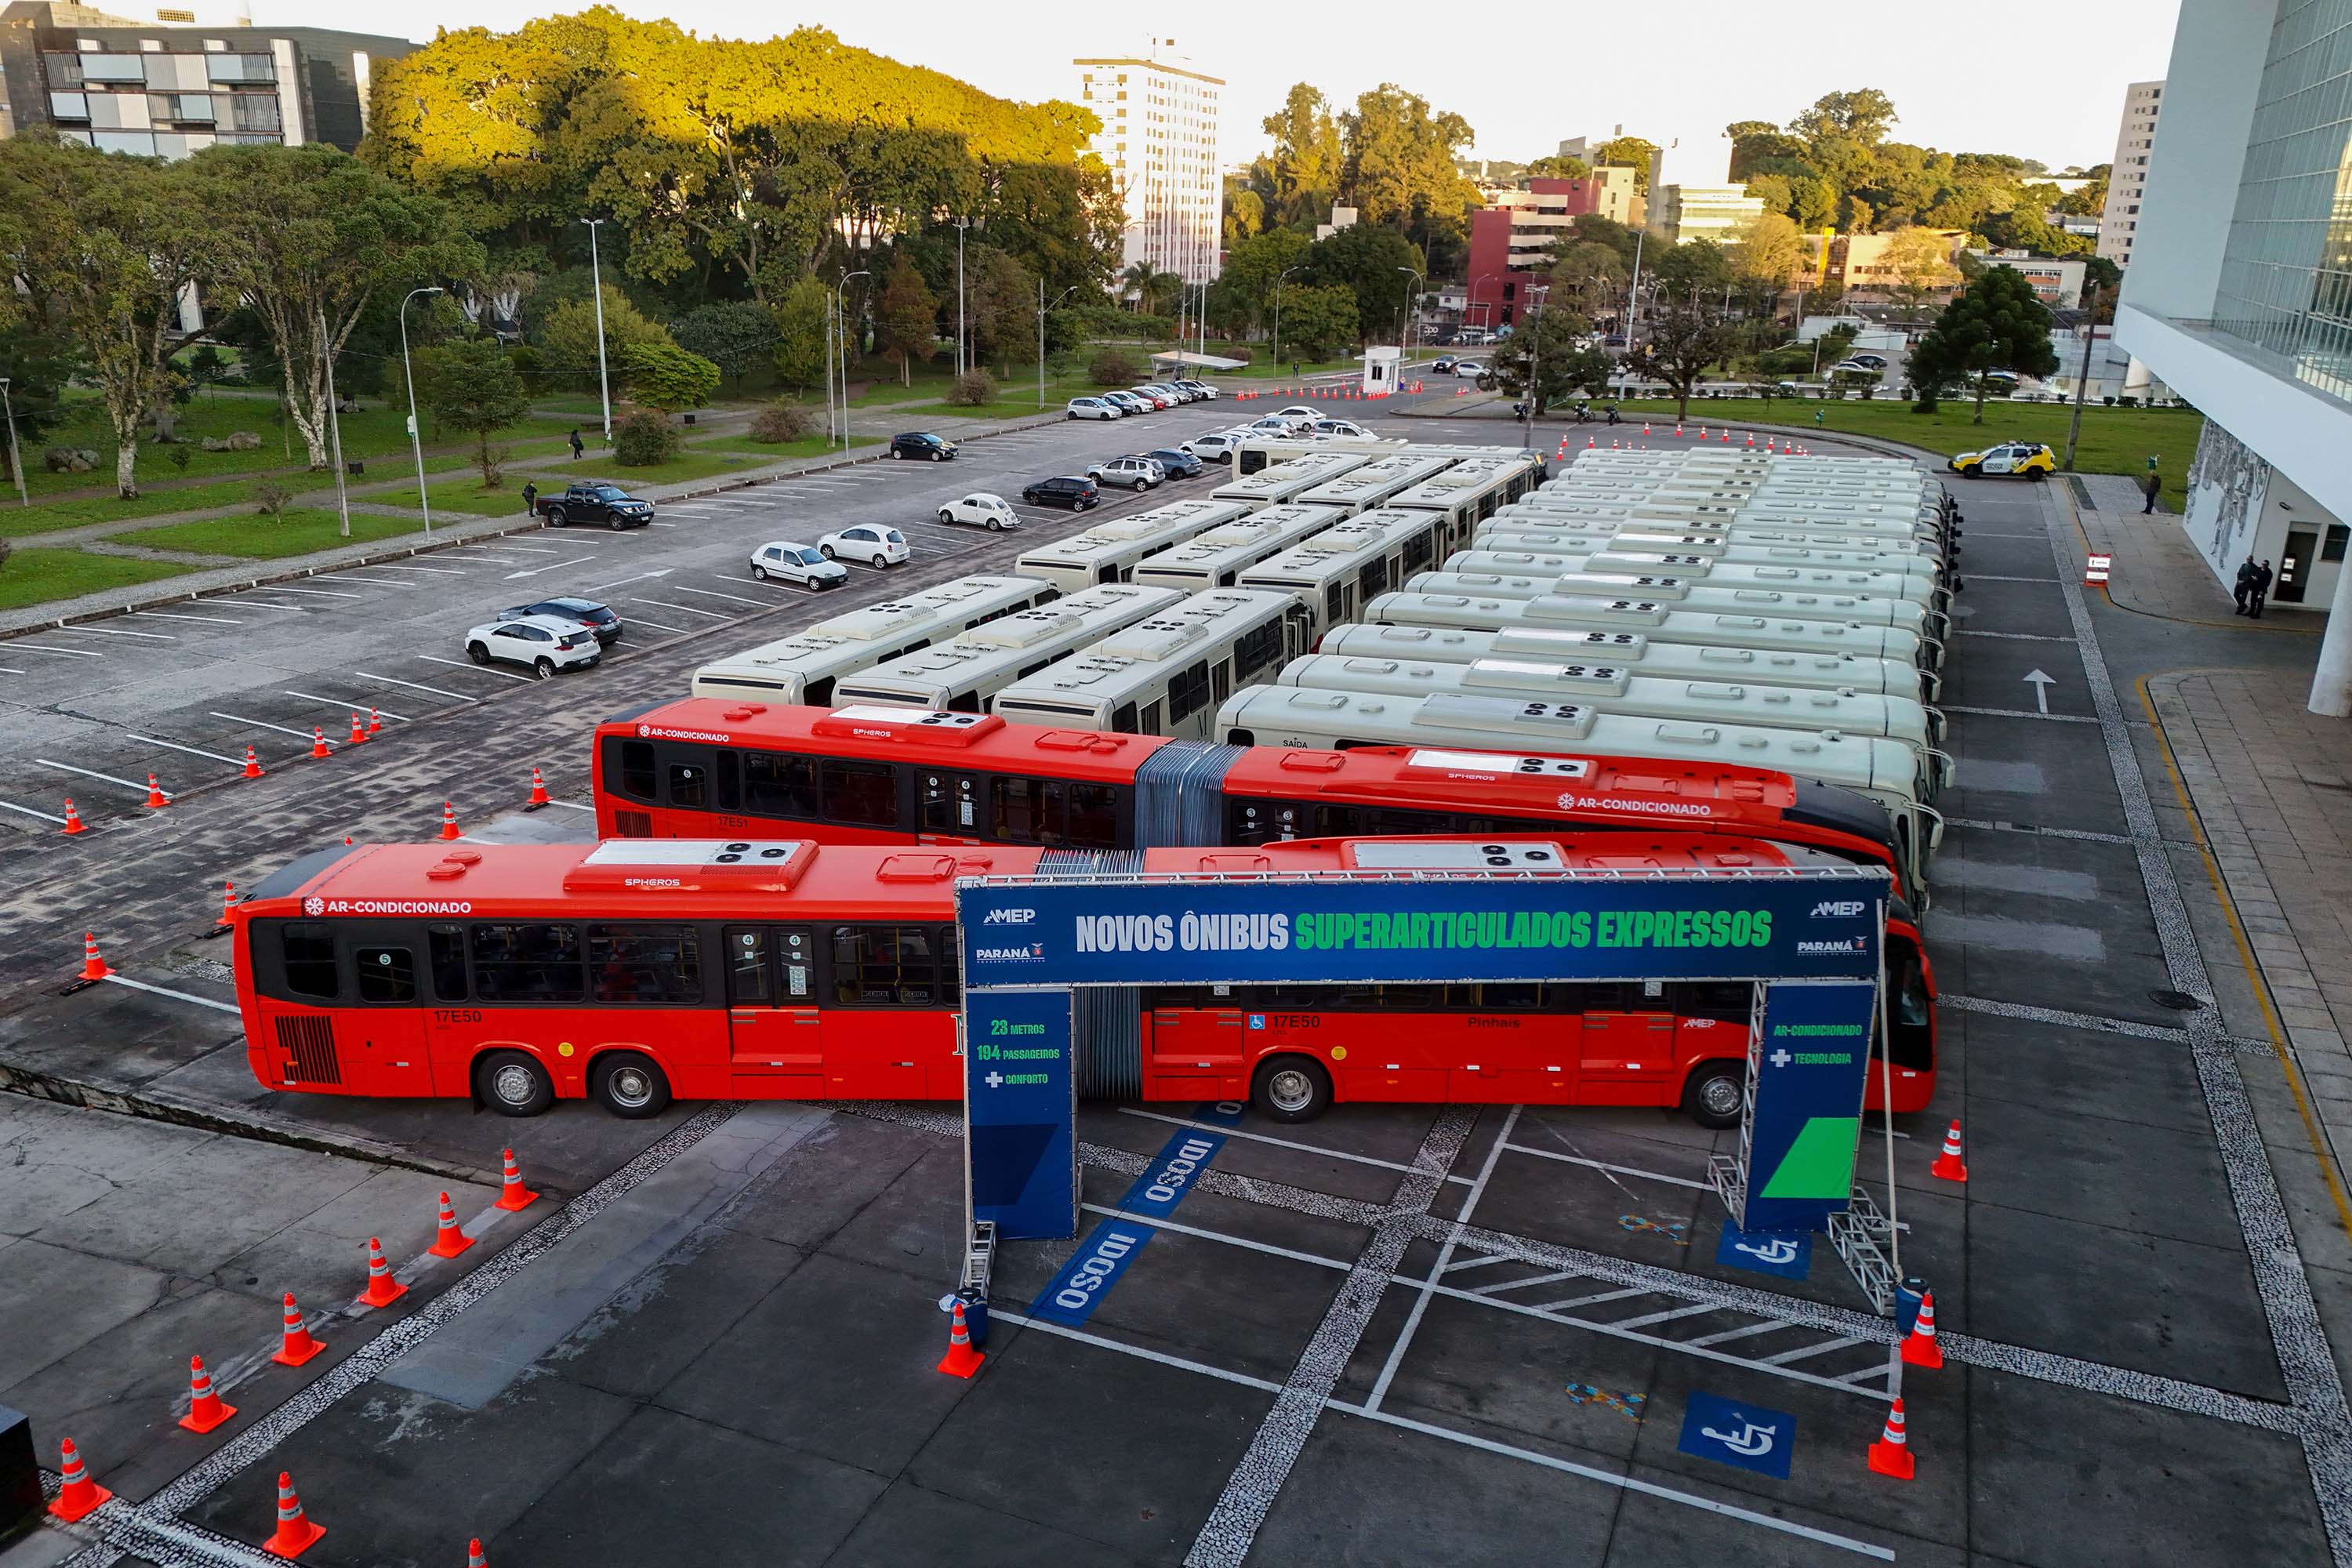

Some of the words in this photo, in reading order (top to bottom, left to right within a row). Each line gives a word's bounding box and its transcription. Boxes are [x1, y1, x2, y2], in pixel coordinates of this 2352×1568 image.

[651, 728, 729, 742] AR-CONDICIONADO
[852, 728, 891, 738] SPHEROS
[1283, 738, 1308, 749] SAÍDA
[1448, 773, 1496, 782] SPHEROS
[1577, 797, 1711, 816] AR-CONDICIONADO
[717, 816, 748, 828] 17E51
[624, 878, 680, 887] SPHEROS
[327, 900, 472, 913] AR-CONDICIONADO
[1809, 901, 1865, 916] AMEP
[983, 909, 1036, 924] AMEP
[1076, 914, 1174, 953] NOVOS
[1179, 910, 1289, 952] ÔNIBUS
[1295, 911, 1592, 950] SUPERARTICULADOS
[1596, 910, 1773, 948] EXPRESSOS
[976, 946, 1031, 958] PARANÁ
[1797, 940, 1853, 951] PARANÁ
[434, 1010, 482, 1023] 17E50
[1272, 1015, 1320, 1028] 17E50
[1468, 1016, 1520, 1029] Pinhais
[1682, 1018, 1716, 1028] AMEP
[991, 1019, 1008, 1035] 23
[1011, 1024, 1045, 1035] METROS
[1773, 1025, 1863, 1036] AR-CONDICIONADO
[977, 1045, 1000, 1060] 194
[1003, 1049, 1060, 1060] PASSAGEIROS
[1794, 1053, 1852, 1065] TECNOLOGIA
[1005, 1073, 1048, 1084] CONFORTO
[1145, 1138, 1214, 1202] IDOSO
[1056, 1232, 1138, 1308] IDOSO
